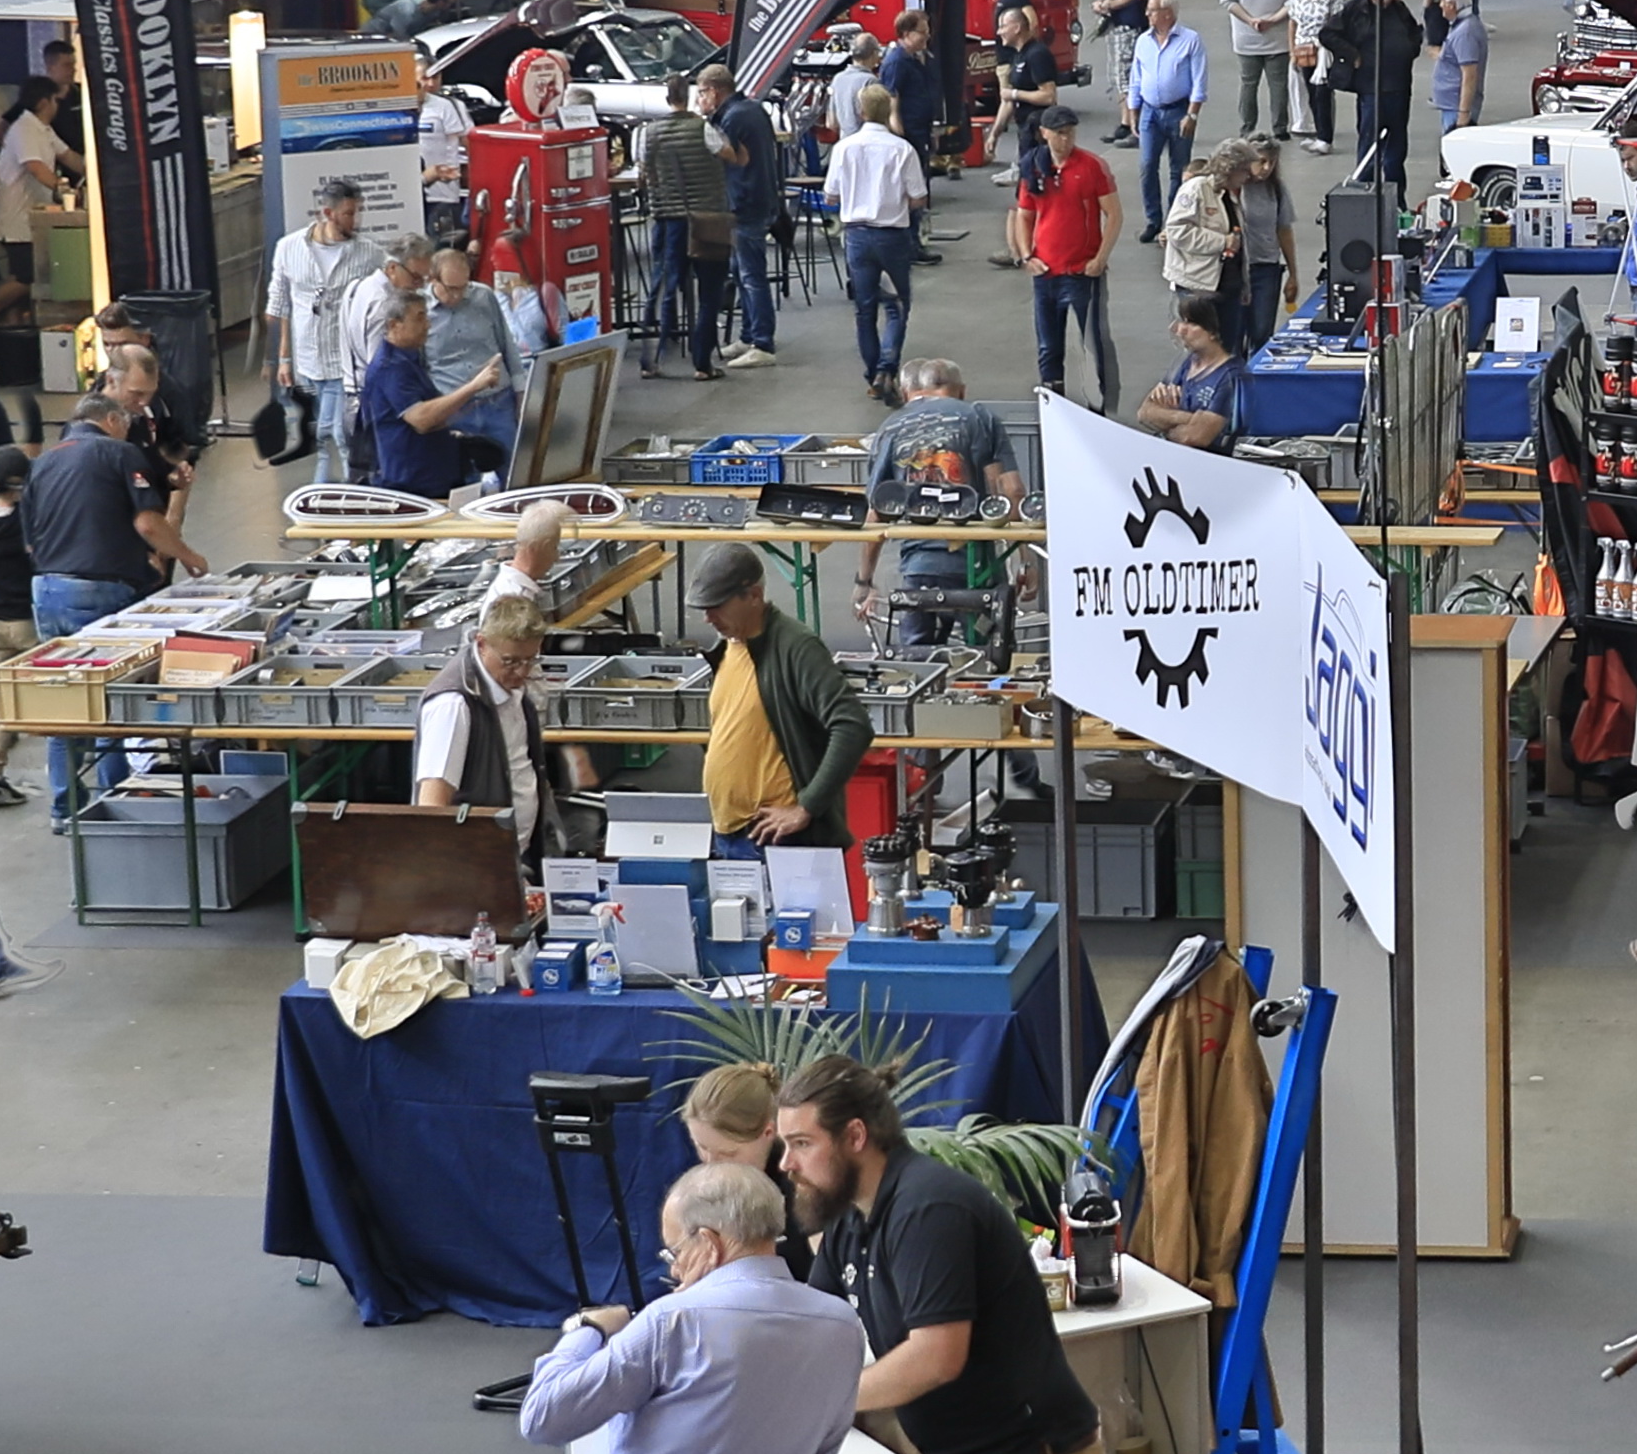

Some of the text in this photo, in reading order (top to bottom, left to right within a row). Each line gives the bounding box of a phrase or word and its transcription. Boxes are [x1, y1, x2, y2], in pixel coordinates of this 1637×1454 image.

[748, 6, 770, 34] the
[317, 61, 399, 86] BROOKLYN
[104, 68, 130, 153] Garage
[1073, 558, 1260, 617] FM OLDTIMER
